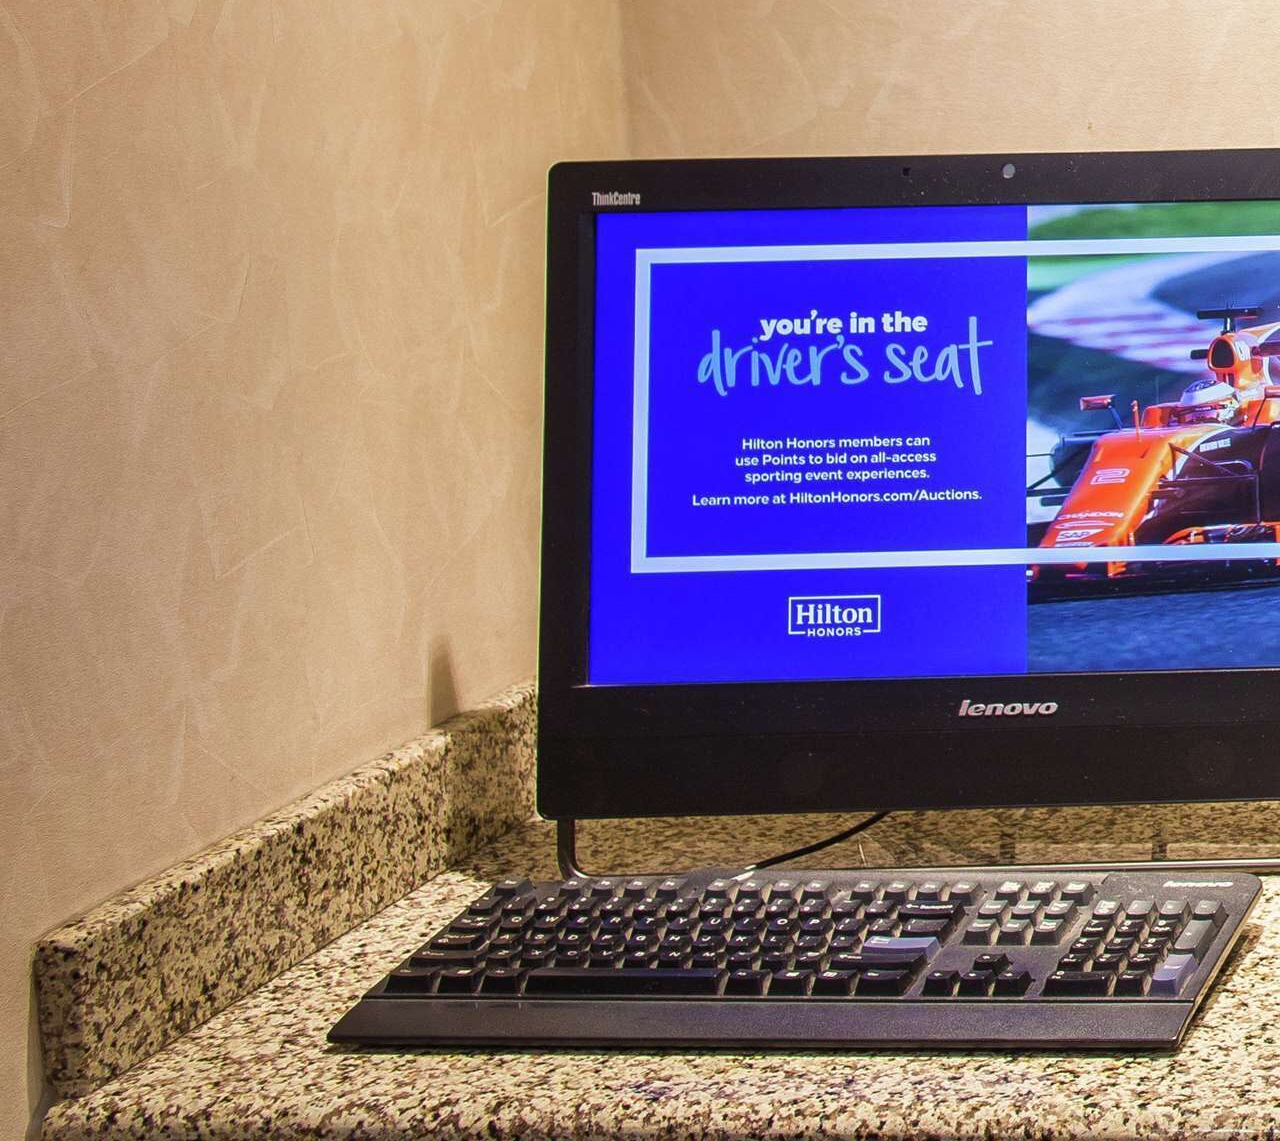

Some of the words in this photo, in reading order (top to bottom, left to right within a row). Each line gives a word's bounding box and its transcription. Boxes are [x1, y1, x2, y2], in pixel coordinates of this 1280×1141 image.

[592, 191, 641, 206] ThinkCentre
[759, 309, 843, 340] you're
[849, 311, 875, 334] in
[881, 311, 928, 332] the
[697, 329, 869, 396] driver's
[883, 316, 993, 395] seat
[742, 437, 783, 450] Hilton
[786, 437, 836, 448] Honors
[839, 435, 902, 447] members
[906, 437, 930, 446] can
[735, 456, 758, 466] use
[762, 453, 805, 466] Points
[808, 454, 823, 465] to
[826, 452, 847, 464] bid
[850, 454, 868, 463] on
[871, 451, 936, 464] all-access
[744, 470, 802, 484] sporting
[805, 469, 843, 481] event
[846, 468, 930, 482] experiences.
[1090, 468, 1130, 485] 2
[692, 494, 730, 506] Learn
[734, 495, 769, 505] more
[772, 494, 786, 504] at
[789, 488, 982, 505] HiltonHonors.com/Auctions.
[1059, 531, 1090, 541] SAP
[796, 604, 873, 624] Hilton
[807, 627, 861, 637] HONORS
[959, 700, 1058, 716] lenovo
